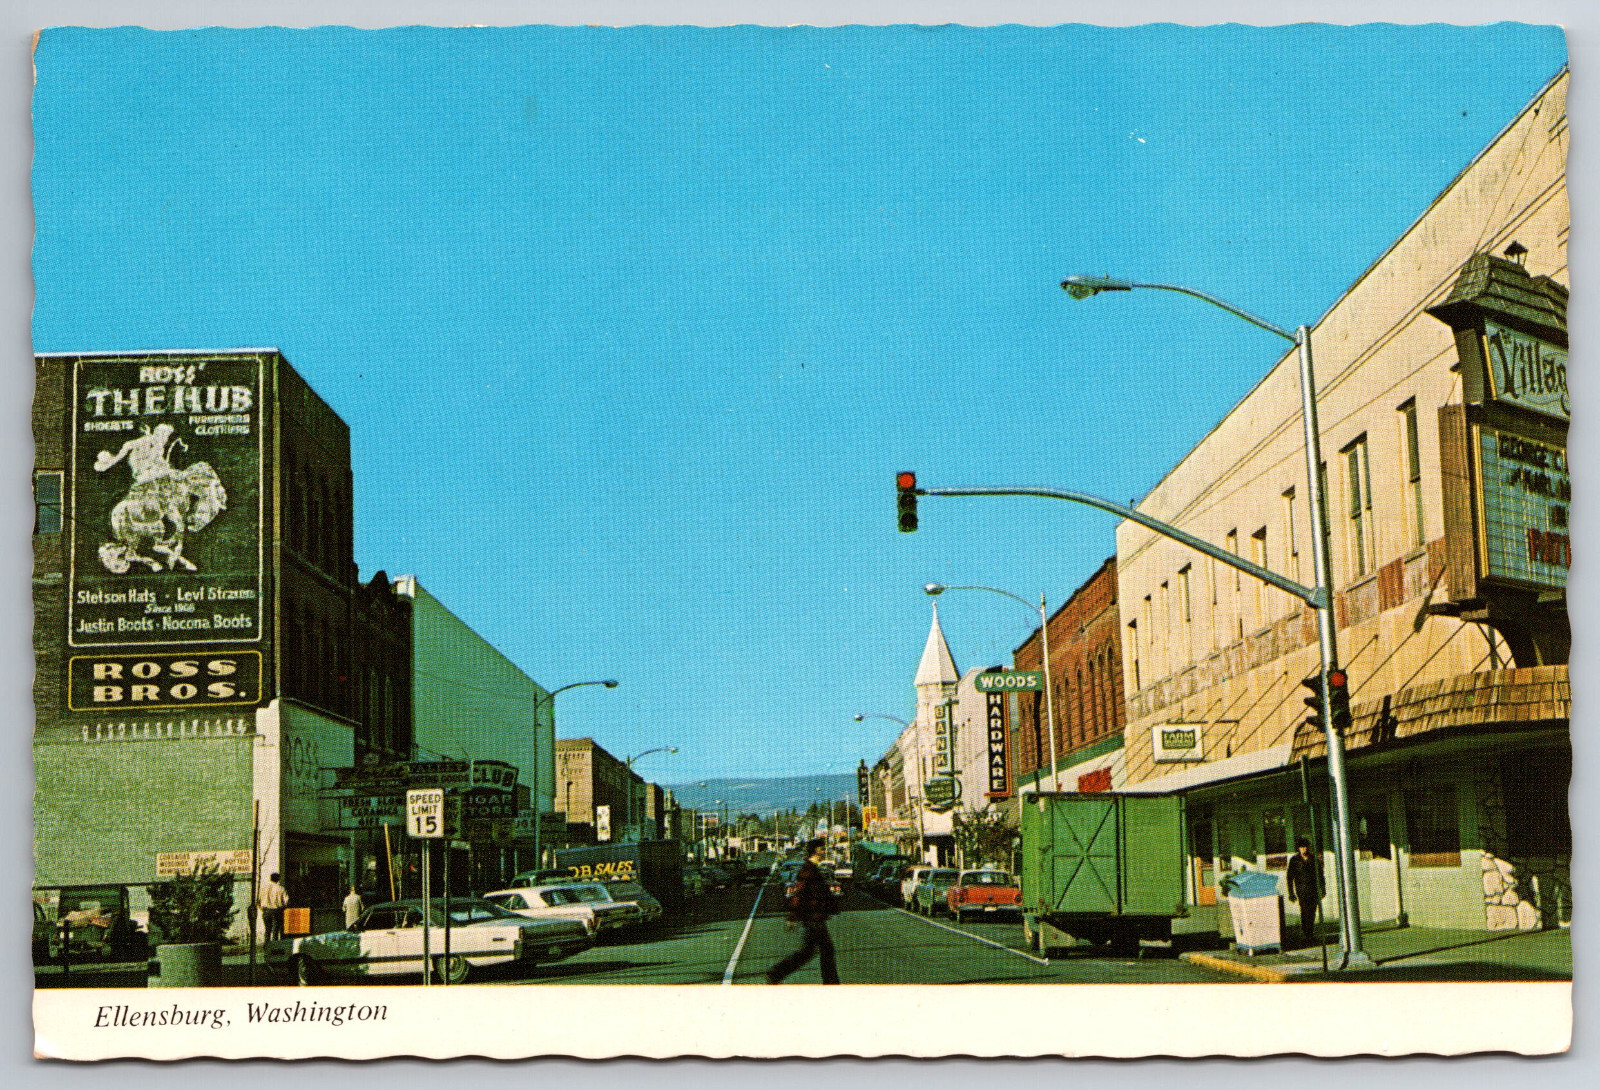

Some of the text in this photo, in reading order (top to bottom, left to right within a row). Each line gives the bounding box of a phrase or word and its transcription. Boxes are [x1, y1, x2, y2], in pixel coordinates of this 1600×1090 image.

[86, 385, 253, 417] THE HUB
[77, 590, 126, 604] Stetson
[129, 588, 156, 603] Hats
[77, 614, 253, 633] Justin Boots Nocona Boots
[93, 659, 237, 680] ROSS
[93, 682, 247, 702] BROS.
[980, 676, 1037, 689] WOODS
[936, 705, 947, 767] BANK
[989, 694, 1005, 790] HARDWARE
[473, 767, 515, 787] CLUB
[410, 794, 442, 805] SPEED
[412, 805, 437, 815] LIMIT
[415, 816, 437, 834] 15
[594, 860, 634, 875] SALES
